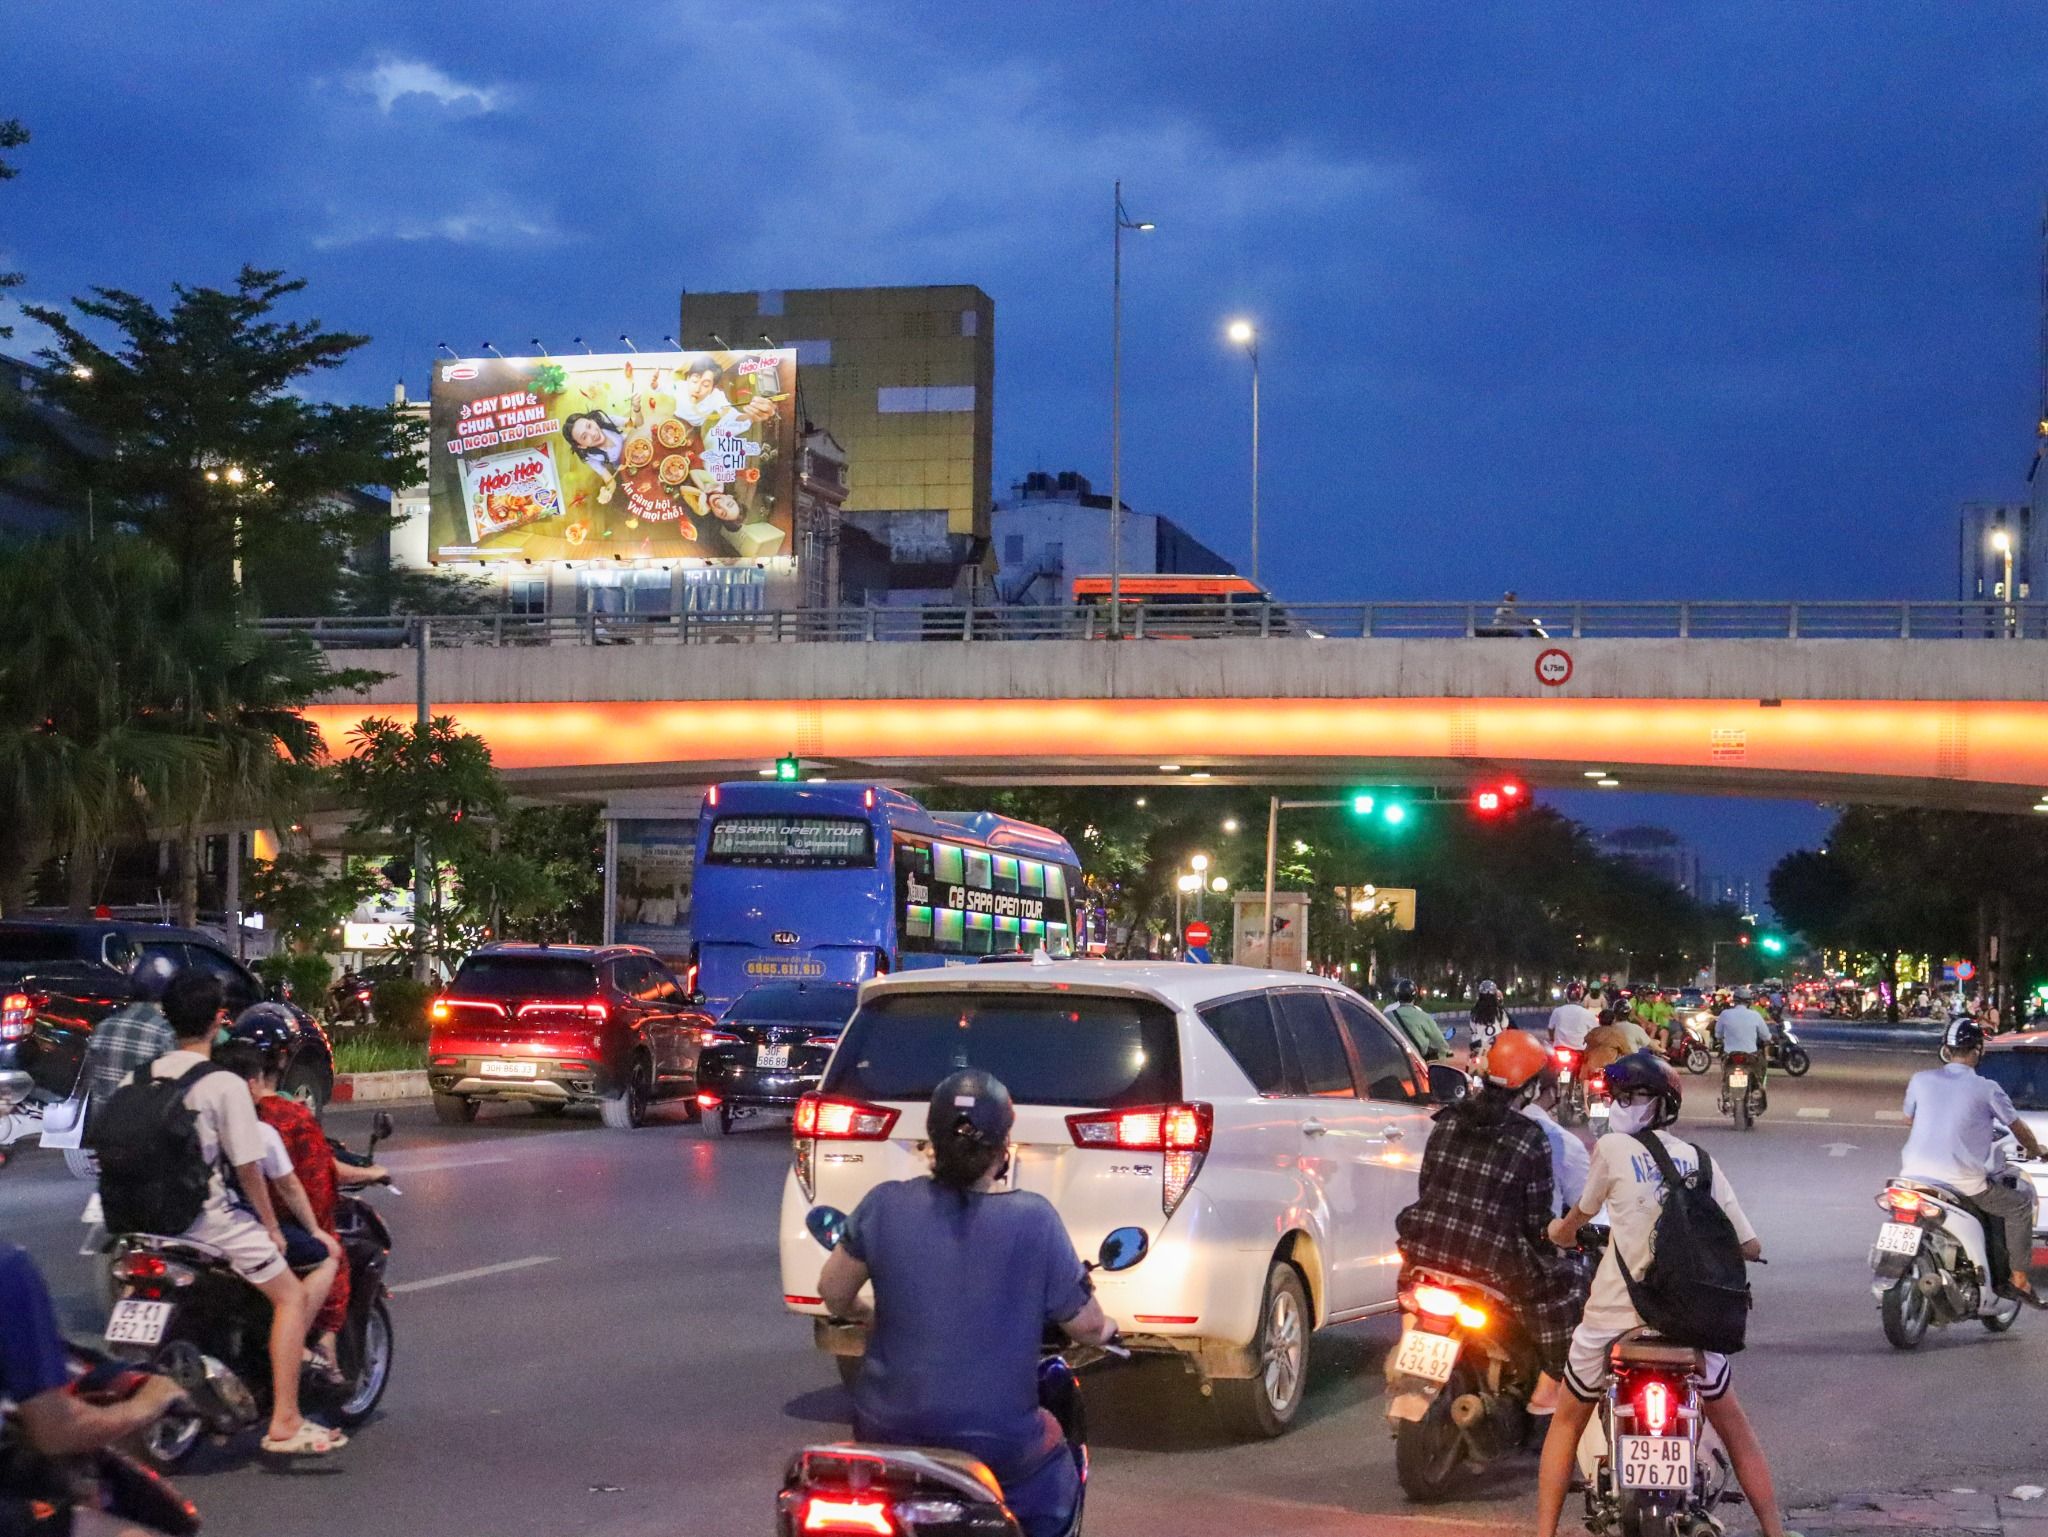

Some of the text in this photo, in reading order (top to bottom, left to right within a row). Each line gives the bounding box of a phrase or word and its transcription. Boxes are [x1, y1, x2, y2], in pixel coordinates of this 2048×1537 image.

[472, 393, 525, 415] CAY DỊU
[458, 406, 545, 435] CHUA THANH
[448, 441, 462, 454] VỊ
[464, 433, 498, 450] NGON
[527, 420, 559, 436] DANH
[723, 450, 744, 469] CHI
[479, 468, 511, 495] Hảo
[514, 456, 544, 482] Hảo
[627, 500, 643, 516] Vui
[643, 510, 660, 522] mọi
[631, 493, 654, 511] cùng
[655, 498, 670, 511] hội
[780, 827, 820, 836] OPEN
[825, 827, 865, 836] TOUR
[966, 890, 993, 913] SAPA
[995, 894, 1020, 917] OPEN
[1020, 898, 1043, 920] TOUR
[774, 933, 796, 943] KIA
[1399, 1352, 1449, 1378] 434.92
[1631, 1440, 1681, 1461] 29-AB
[1625, 1463, 1688, 1486] 976.70
